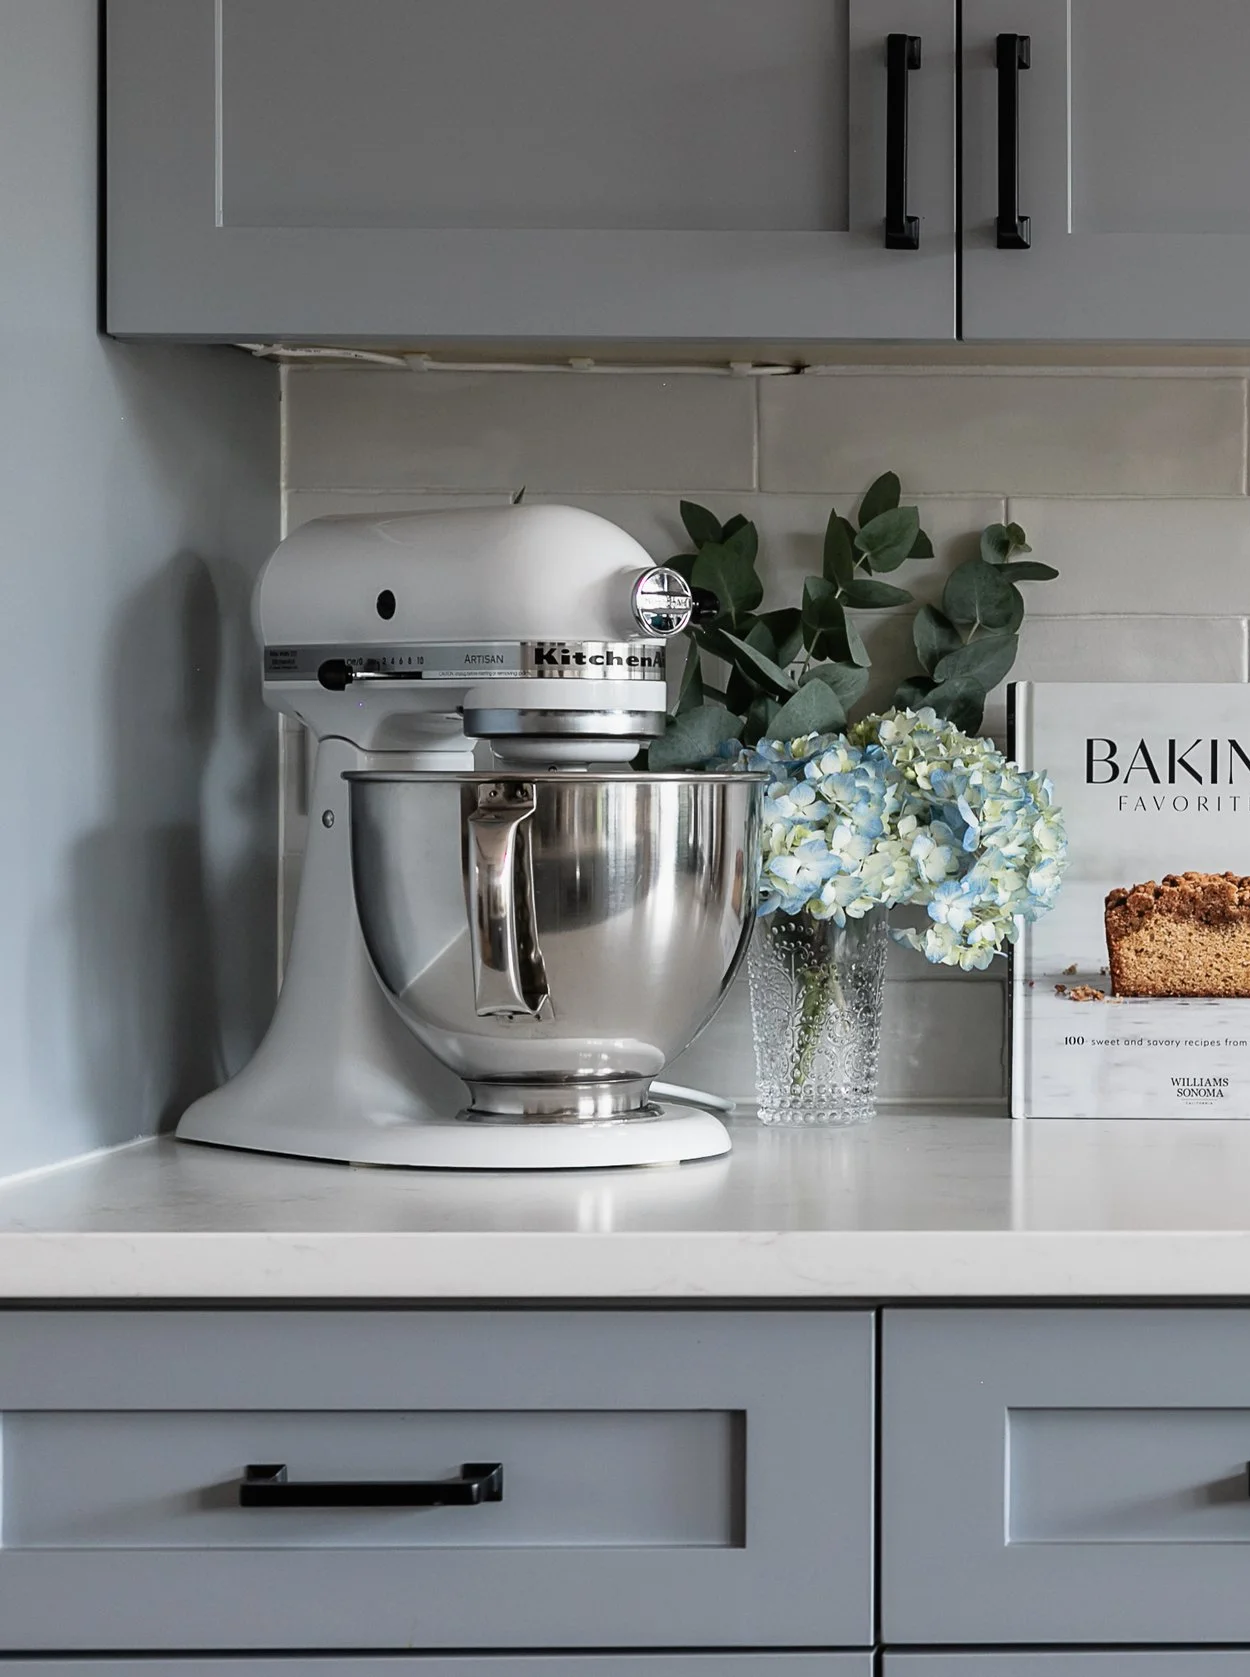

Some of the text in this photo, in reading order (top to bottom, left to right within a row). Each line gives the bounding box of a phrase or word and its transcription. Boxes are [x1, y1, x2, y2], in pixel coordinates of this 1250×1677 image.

[416, 656, 424, 665] 10
[464, 654, 504, 664] ARTISAN
[534, 647, 666, 668] KitchenA
[1064, 1036, 1085, 1046] 100
[1091, 1038, 1120, 1046] sweet
[1124, 1037, 1143, 1047] and
[1147, 1039, 1181, 1048] savory
[1184, 1038, 1221, 1048] recipes
[1225, 1037, 1248, 1047] from
[1170, 1077, 1229, 1087] WILLIAMS
[1176, 1088, 1224, 1098] SONOMA
